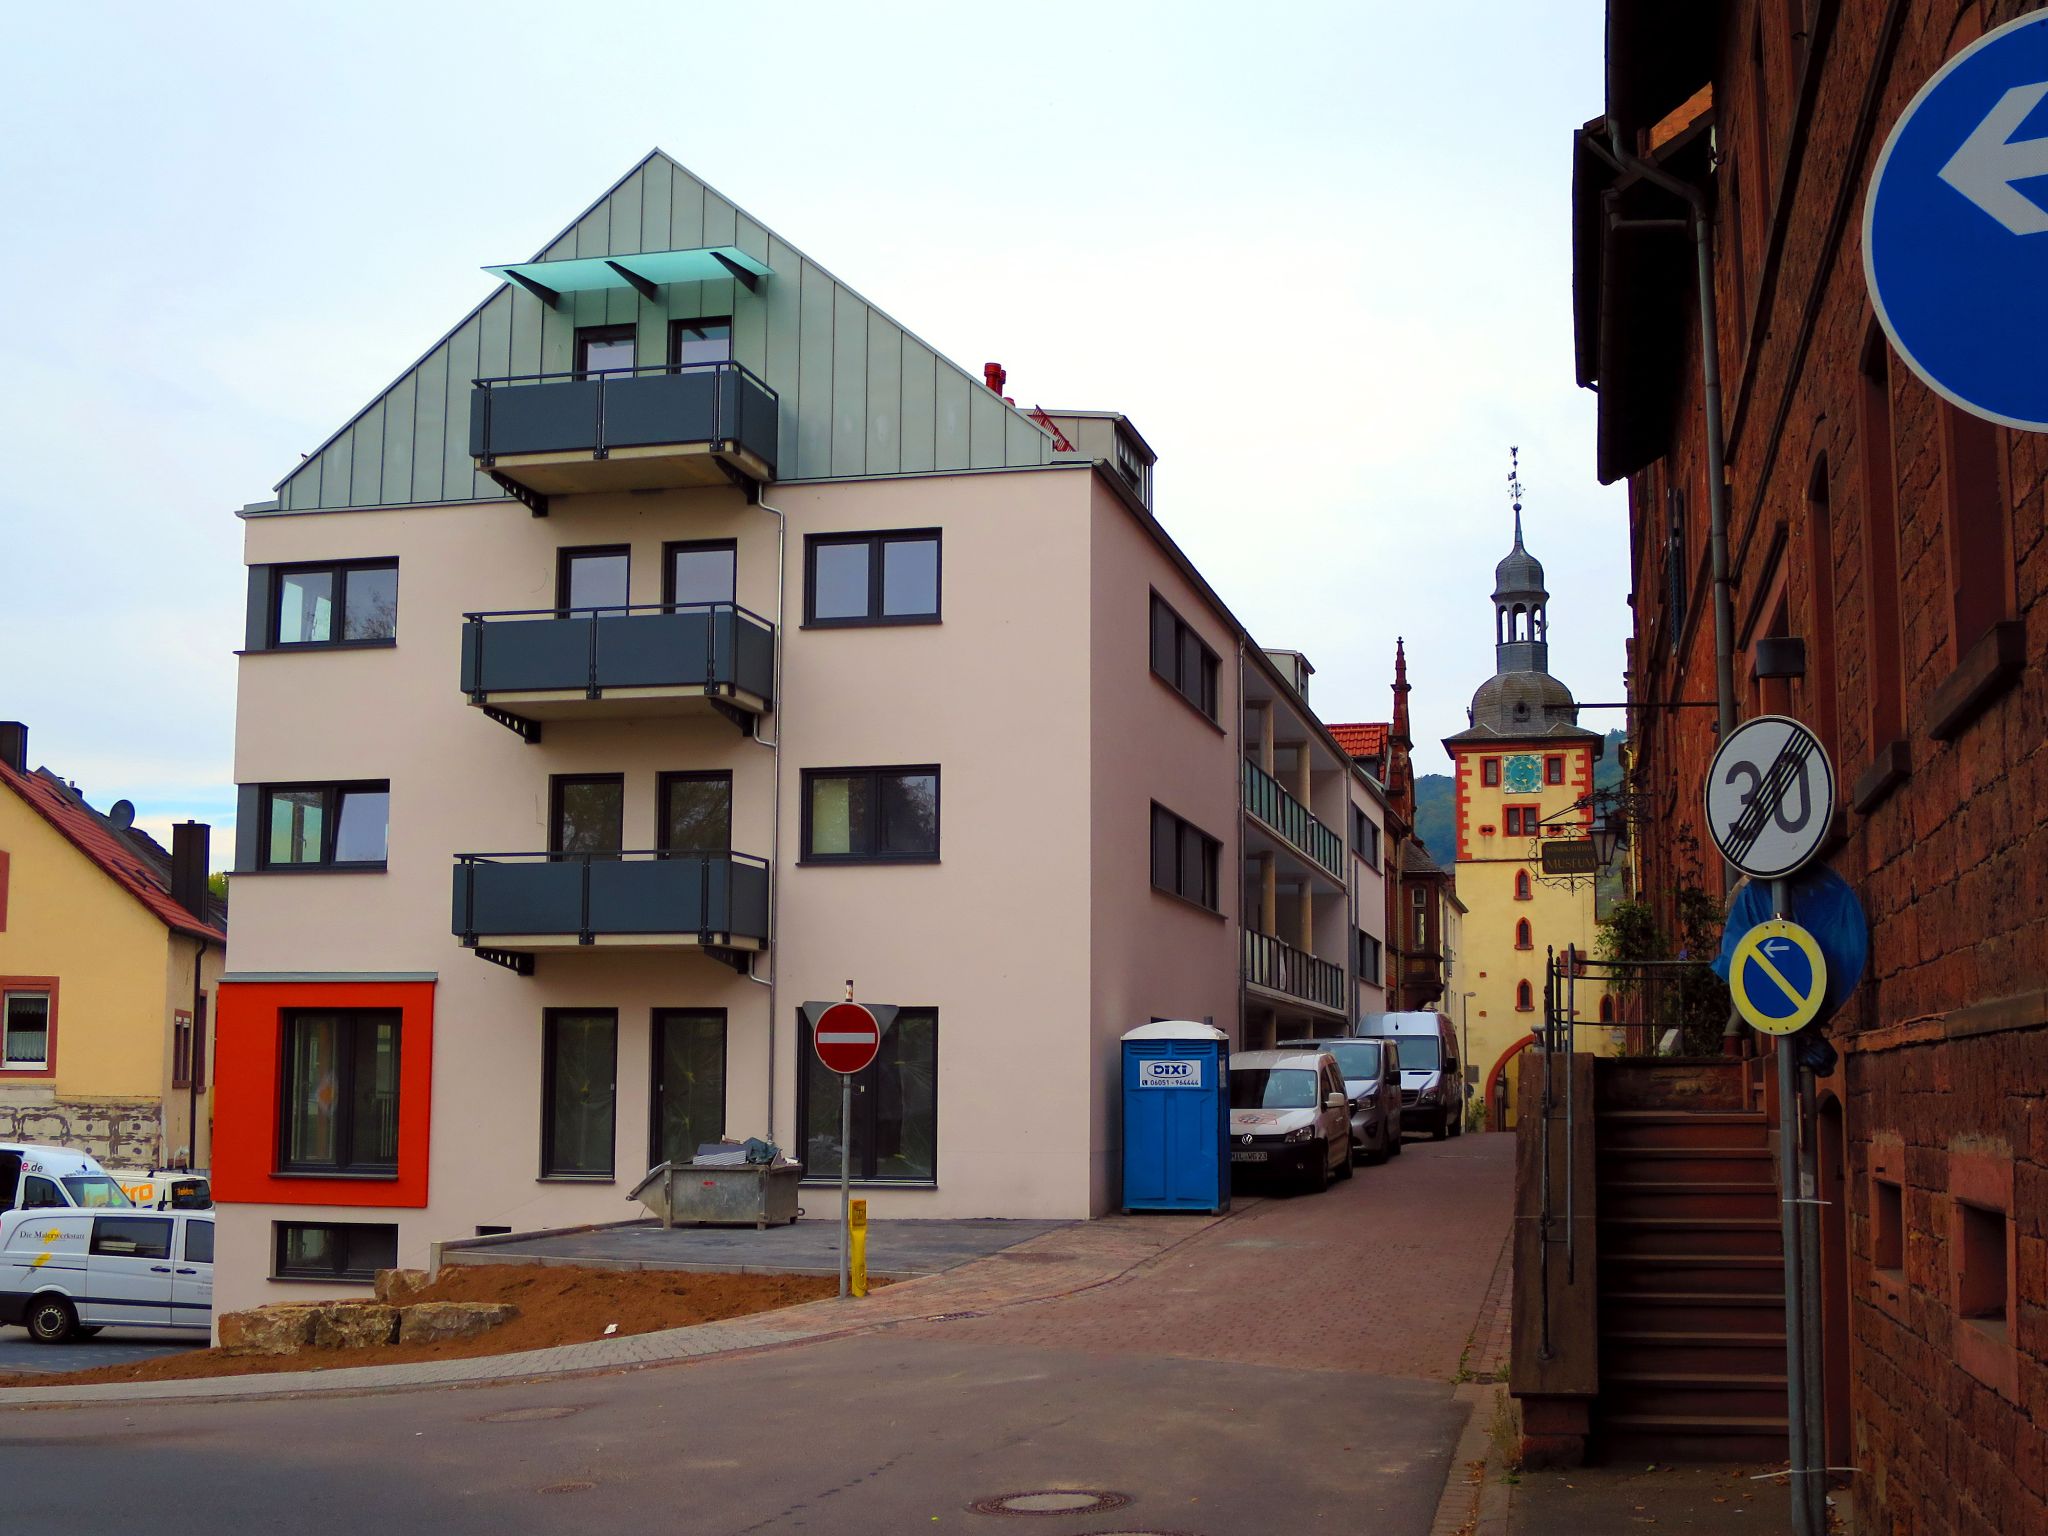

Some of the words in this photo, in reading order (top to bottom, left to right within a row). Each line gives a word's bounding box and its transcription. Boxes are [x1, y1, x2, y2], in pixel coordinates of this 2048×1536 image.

[1725, 751, 1812, 842] 30
[1546, 857, 1597, 870] MUSEUM
[20, 1230, 33, 1239] Die
[34, 1231, 86, 1240] Malerwerkstatt
